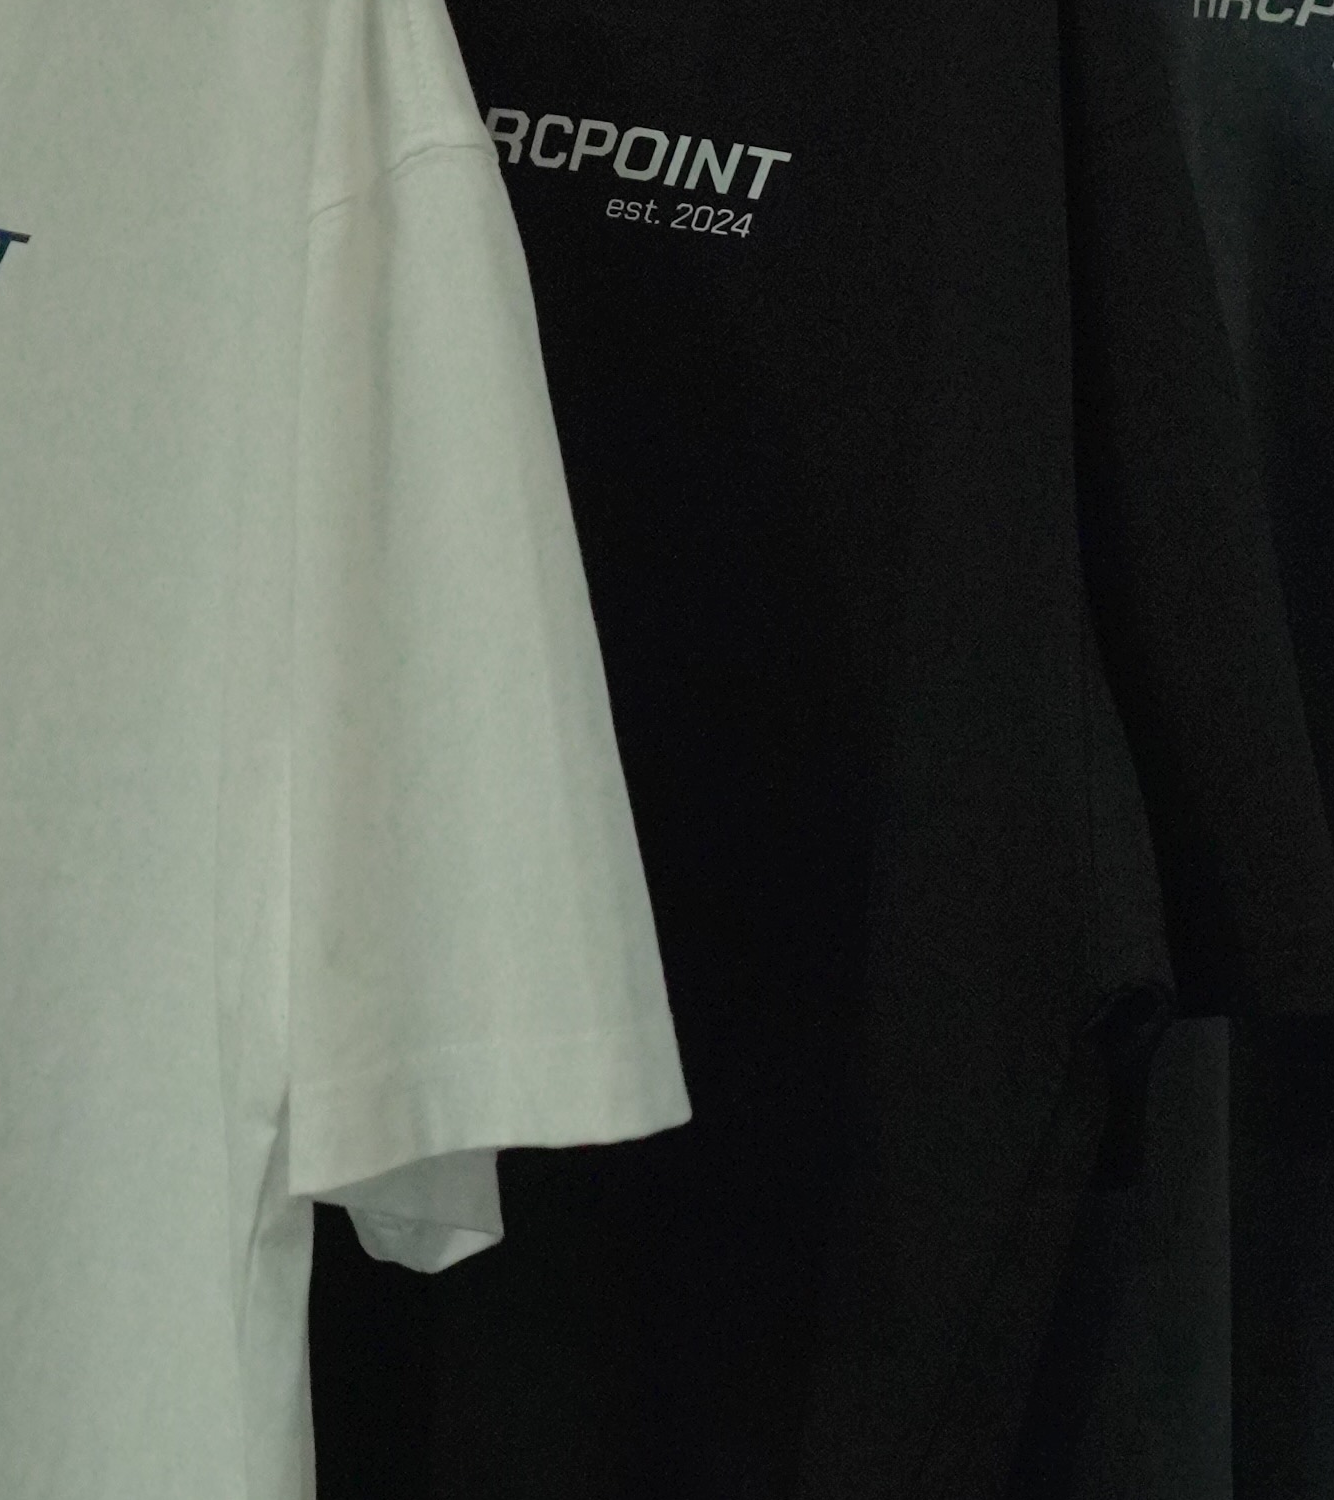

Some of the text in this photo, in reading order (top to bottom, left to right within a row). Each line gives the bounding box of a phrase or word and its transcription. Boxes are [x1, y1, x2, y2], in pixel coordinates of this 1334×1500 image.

[484, 106, 793, 200] RCPOINT
[605, 198, 754, 238] est. 2024
